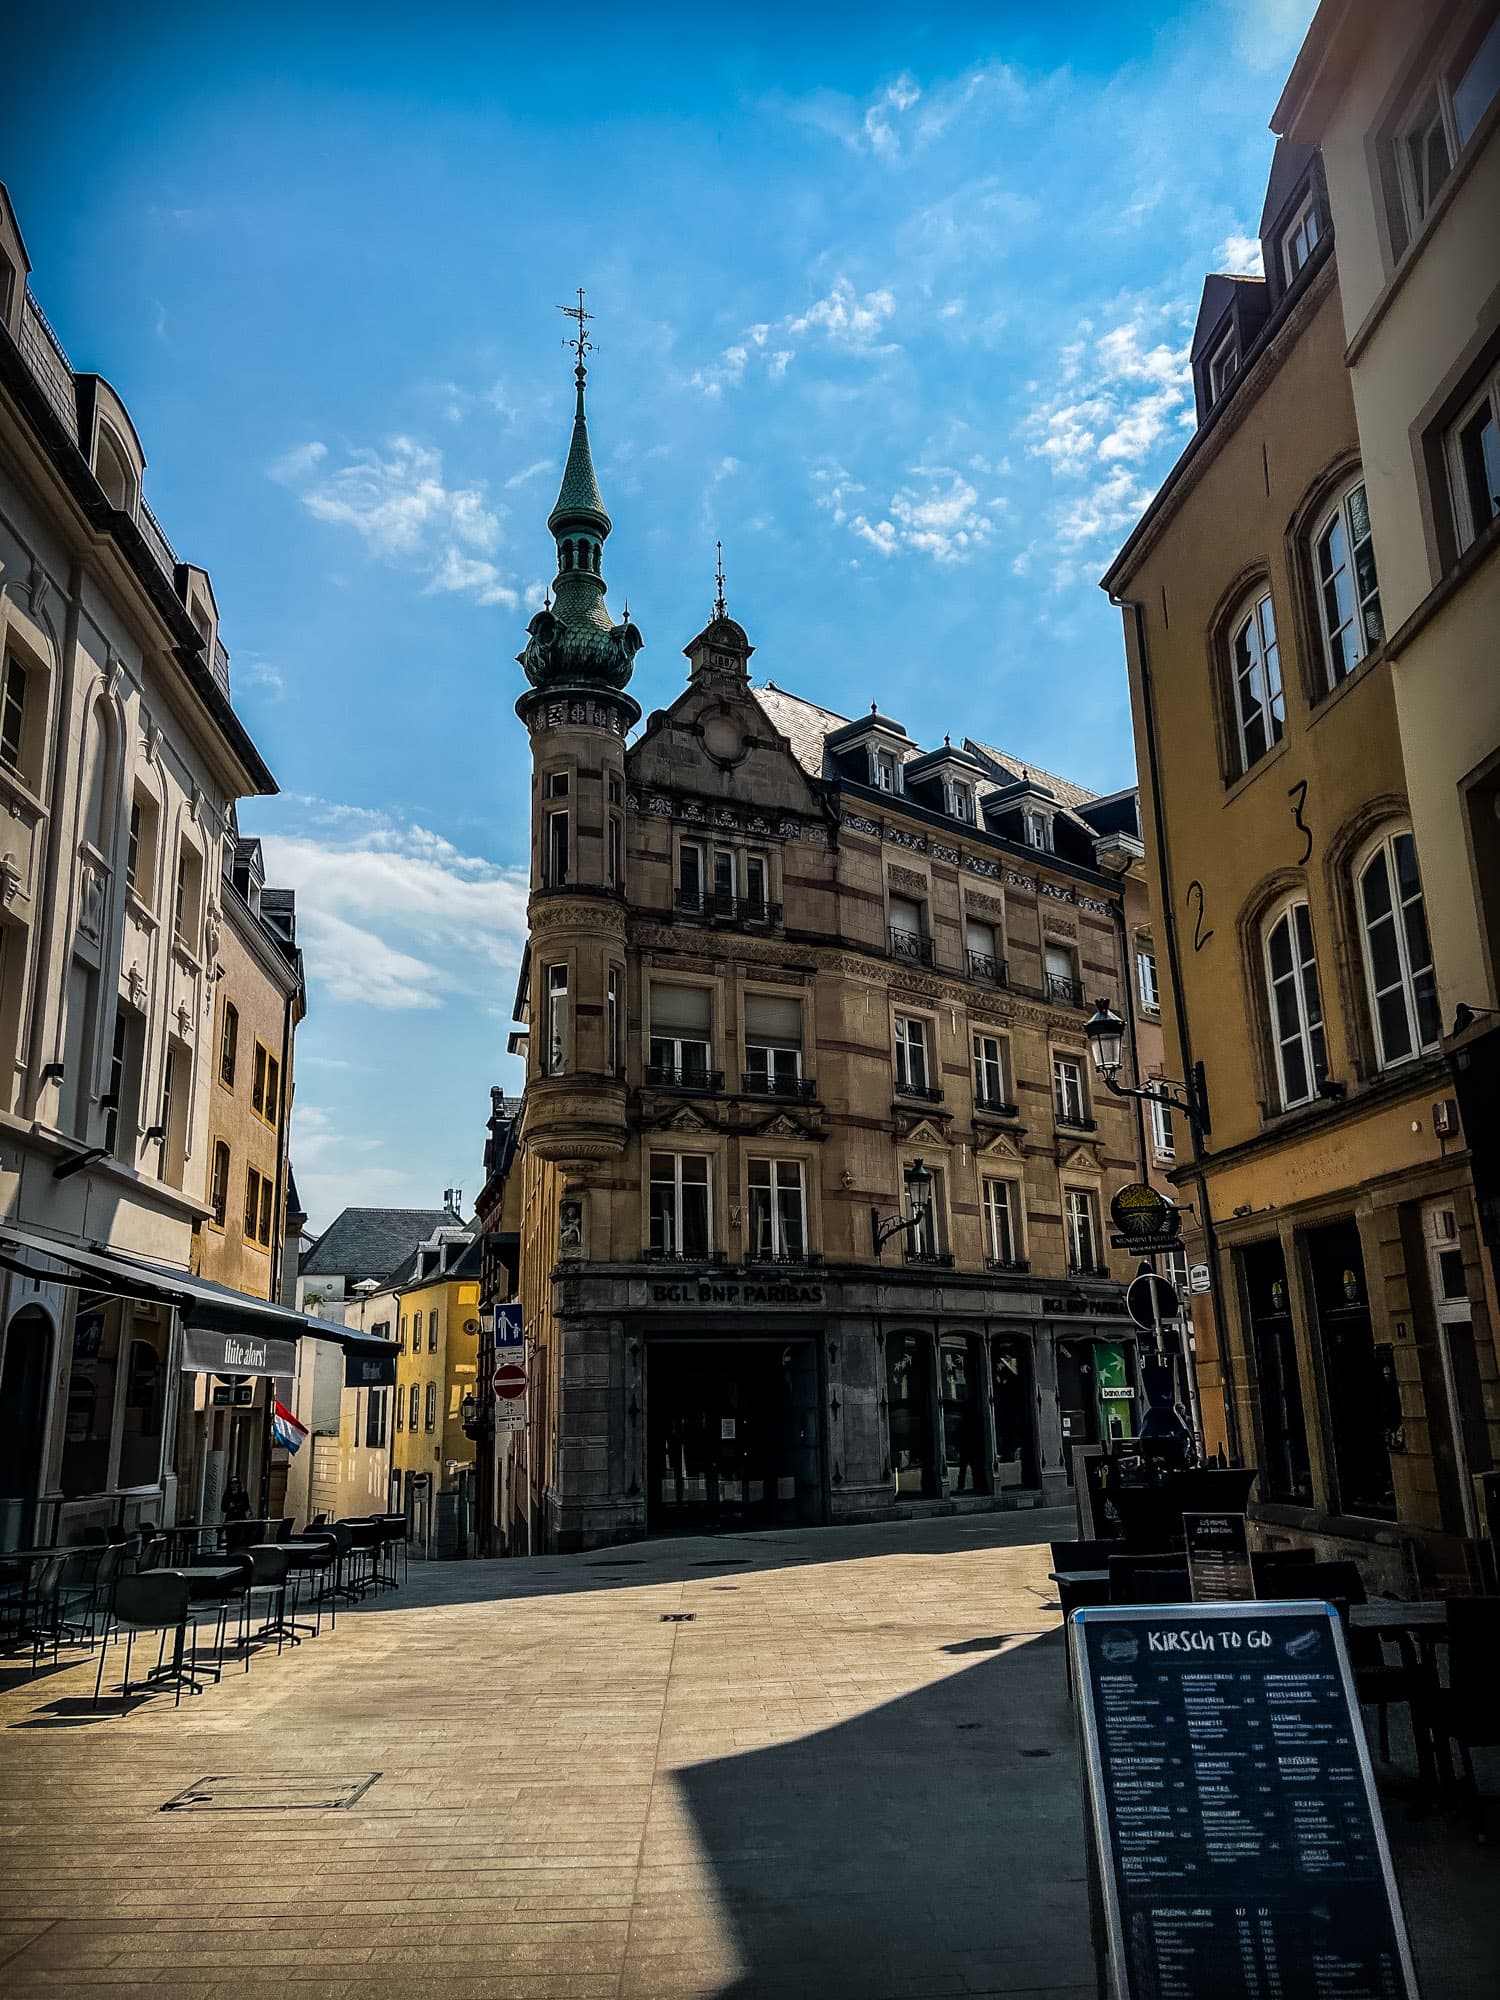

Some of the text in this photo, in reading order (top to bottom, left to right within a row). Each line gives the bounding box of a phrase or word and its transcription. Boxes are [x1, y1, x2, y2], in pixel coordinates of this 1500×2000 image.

[714, 655, 735, 668] 1887
[654, 1285, 824, 1302] BGL BNP PARIBAS
[243, 1343, 267, 1367] alors!
[1219, 1631, 1242, 1649] TO
[1247, 1630, 1273, 1649] GO
